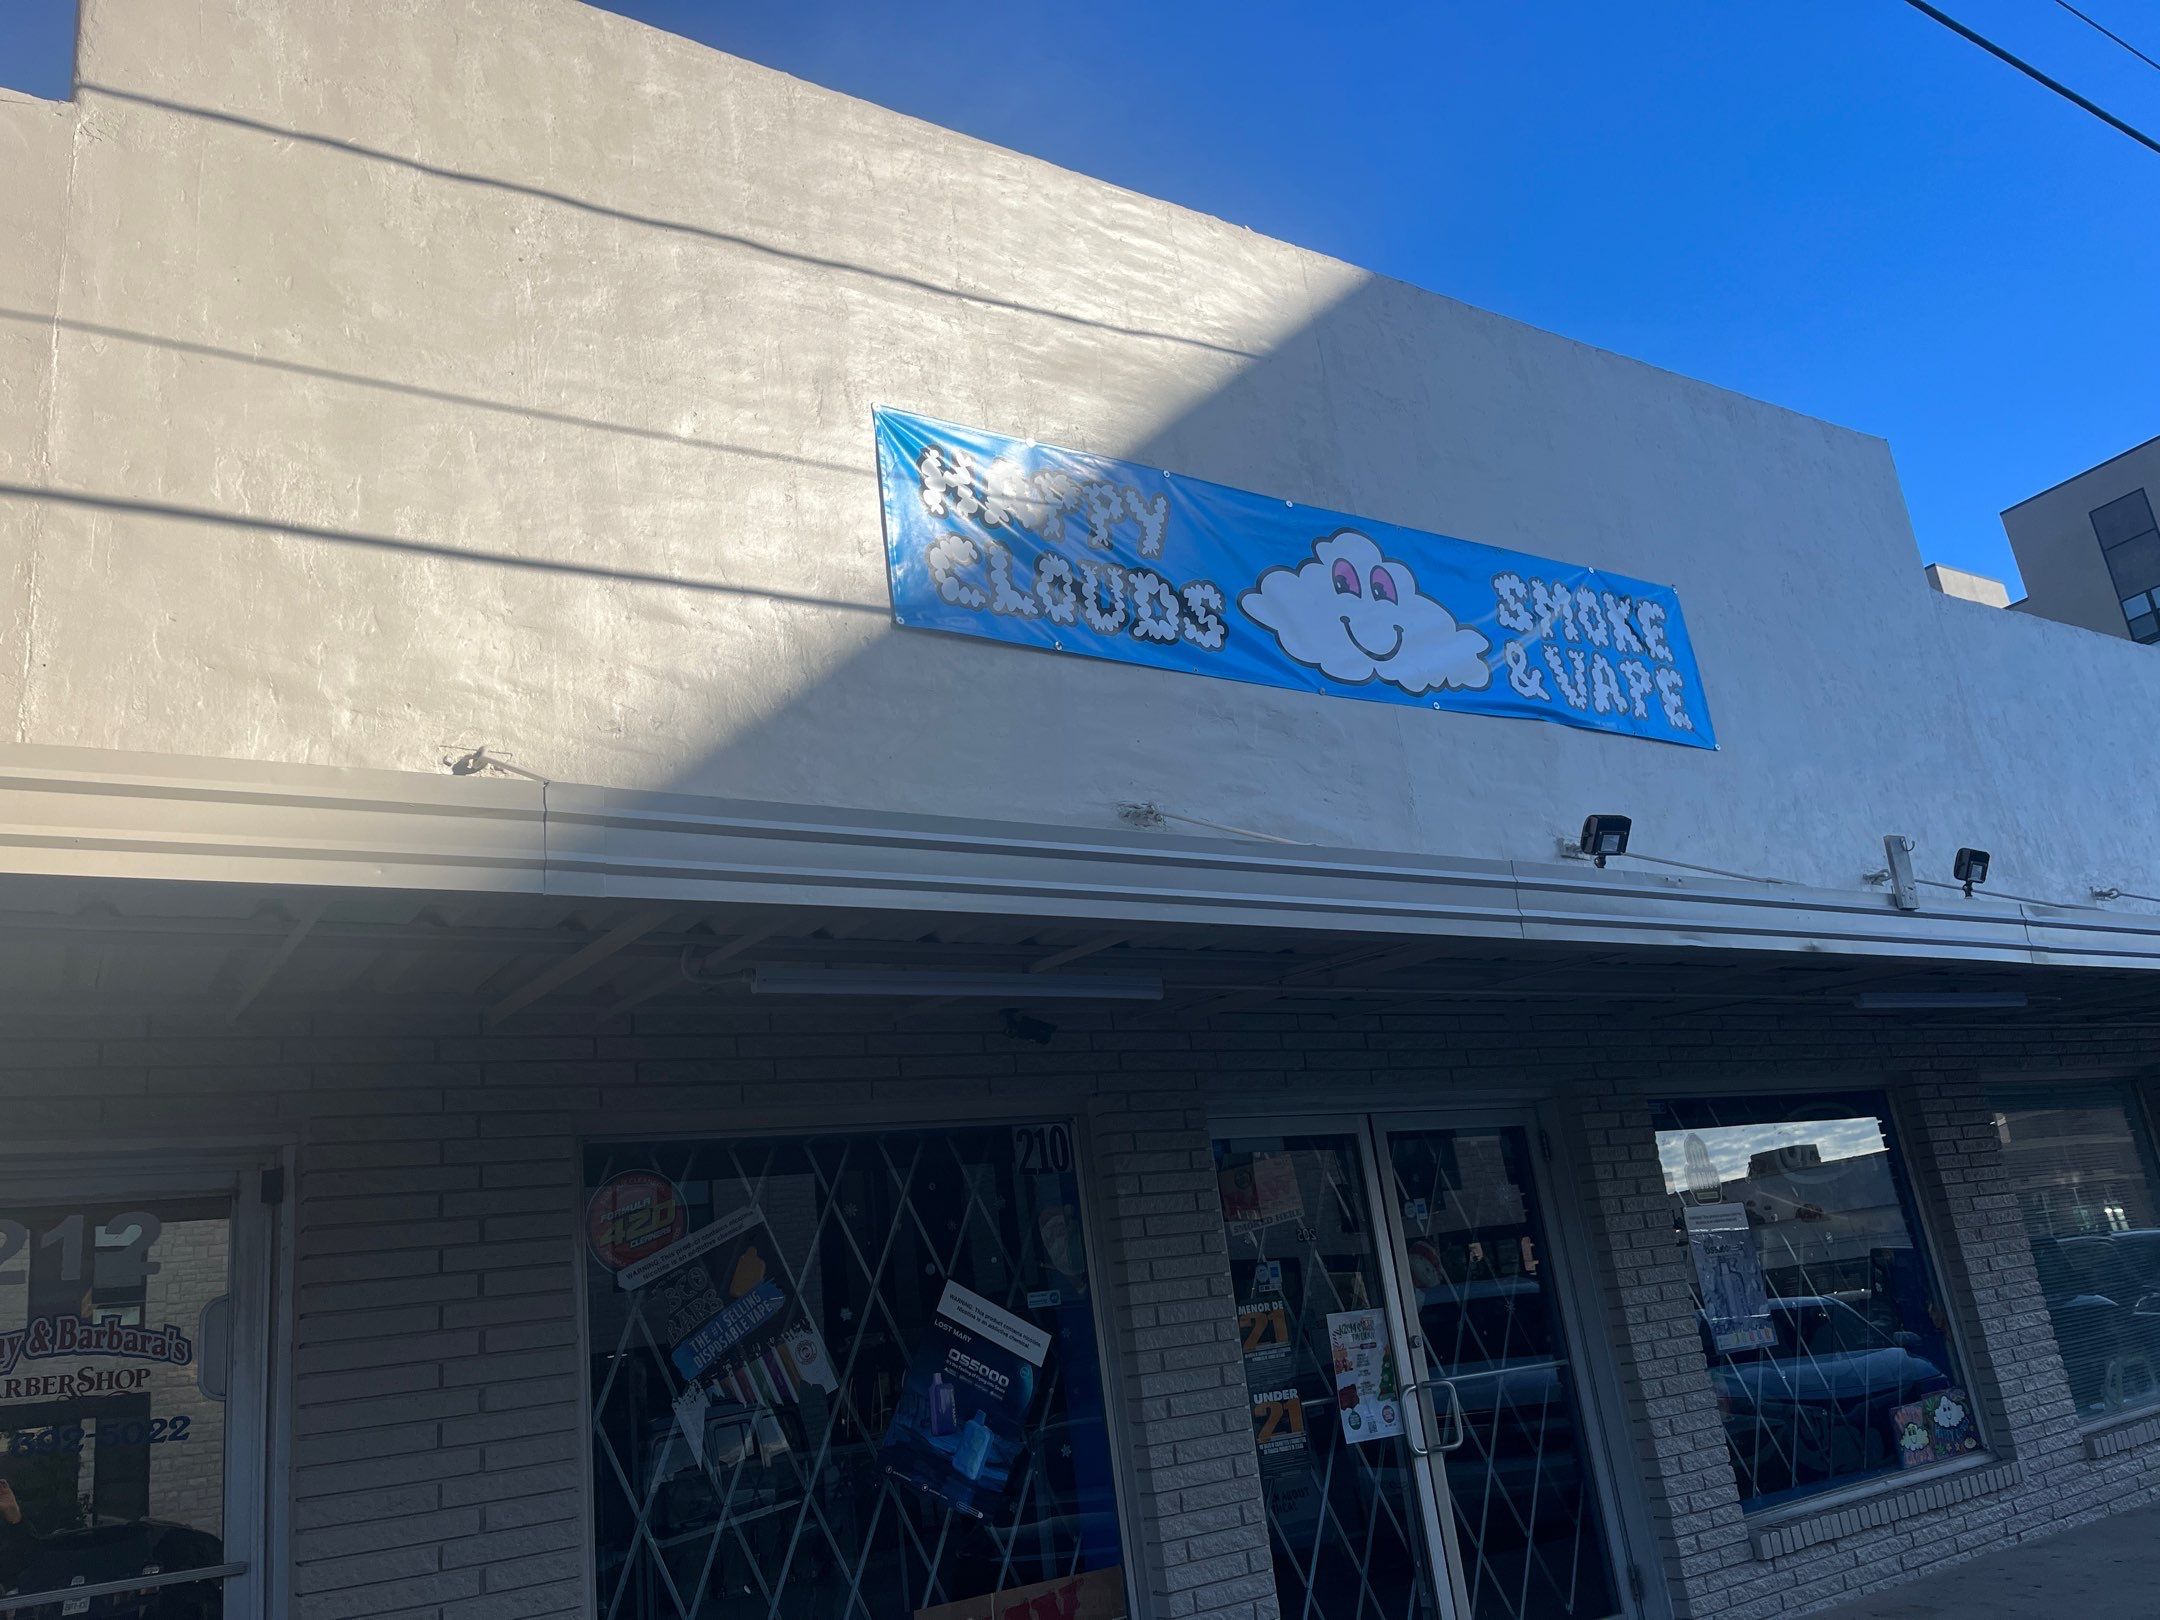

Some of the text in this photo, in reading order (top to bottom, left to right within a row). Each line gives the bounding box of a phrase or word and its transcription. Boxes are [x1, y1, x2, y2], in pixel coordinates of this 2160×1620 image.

[918, 445, 1169, 560] HAPPY
[928, 532, 1229, 651] CLOUDS
[1492, 572, 1673, 663] SMOKE
[1504, 640, 1694, 732] & VAPE
[1016, 1125, 1070, 1174] 210
[598, 1200, 675, 1247] 420
[600, 1198, 651, 1223] FORMULA
[688, 1289, 761, 1354] THE #1 SELLING
[1238, 1300, 1284, 1315] MENOR DE
[29, 1320, 49, 1353] &
[56, 1317, 187, 1362] Barbara's
[692, 1318, 750, 1369] DISPOSABLE
[747, 1299, 773, 1324] VAPE
[934, 1319, 972, 1343] LOST MARY
[1239, 1309, 1289, 1353] 21
[0, 1367, 150, 1399] RBERSHOP
[1254, 1389, 1298, 1404] UNDER
[1254, 1397, 1305, 1443] 21
